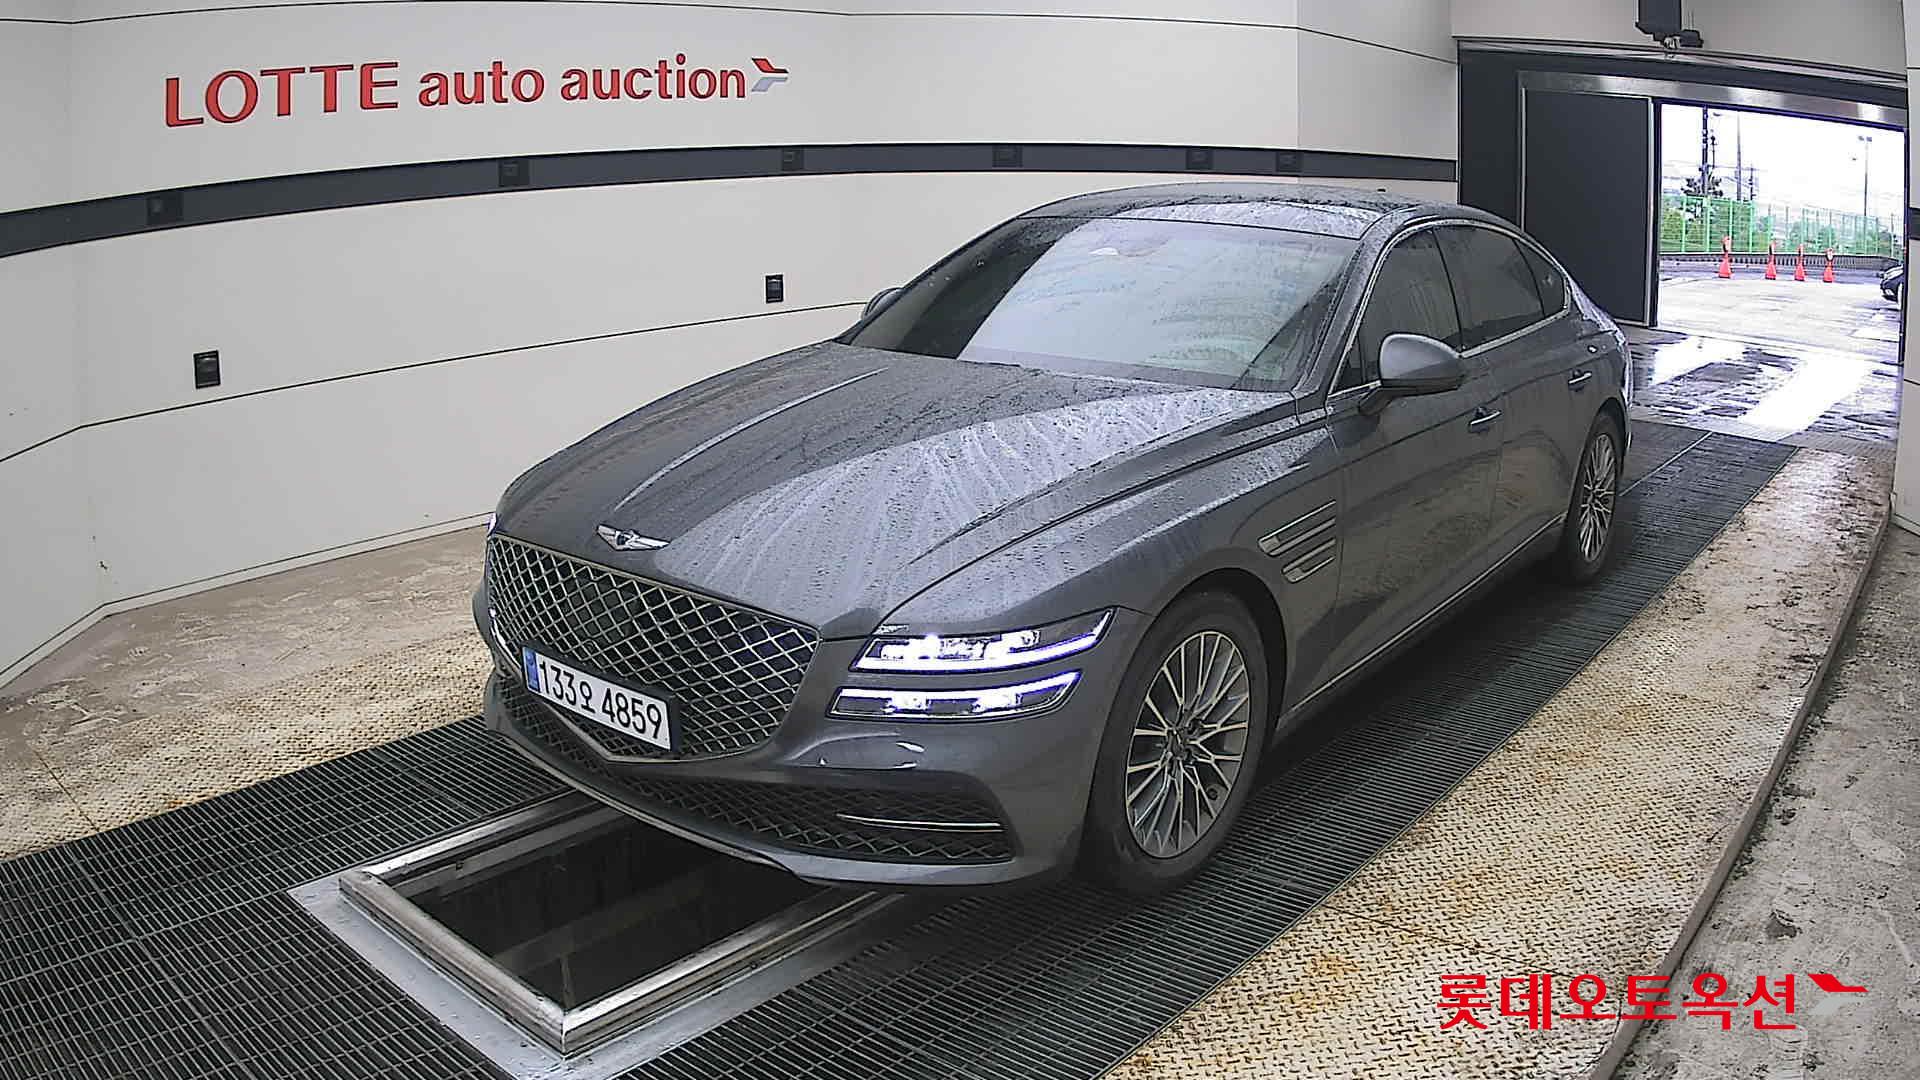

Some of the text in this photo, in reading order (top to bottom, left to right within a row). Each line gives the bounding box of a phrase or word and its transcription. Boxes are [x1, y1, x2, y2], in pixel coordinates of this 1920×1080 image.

[165, 53, 747, 127] LOTTE auto auction
[539, 661, 662, 739] 133오 4859
